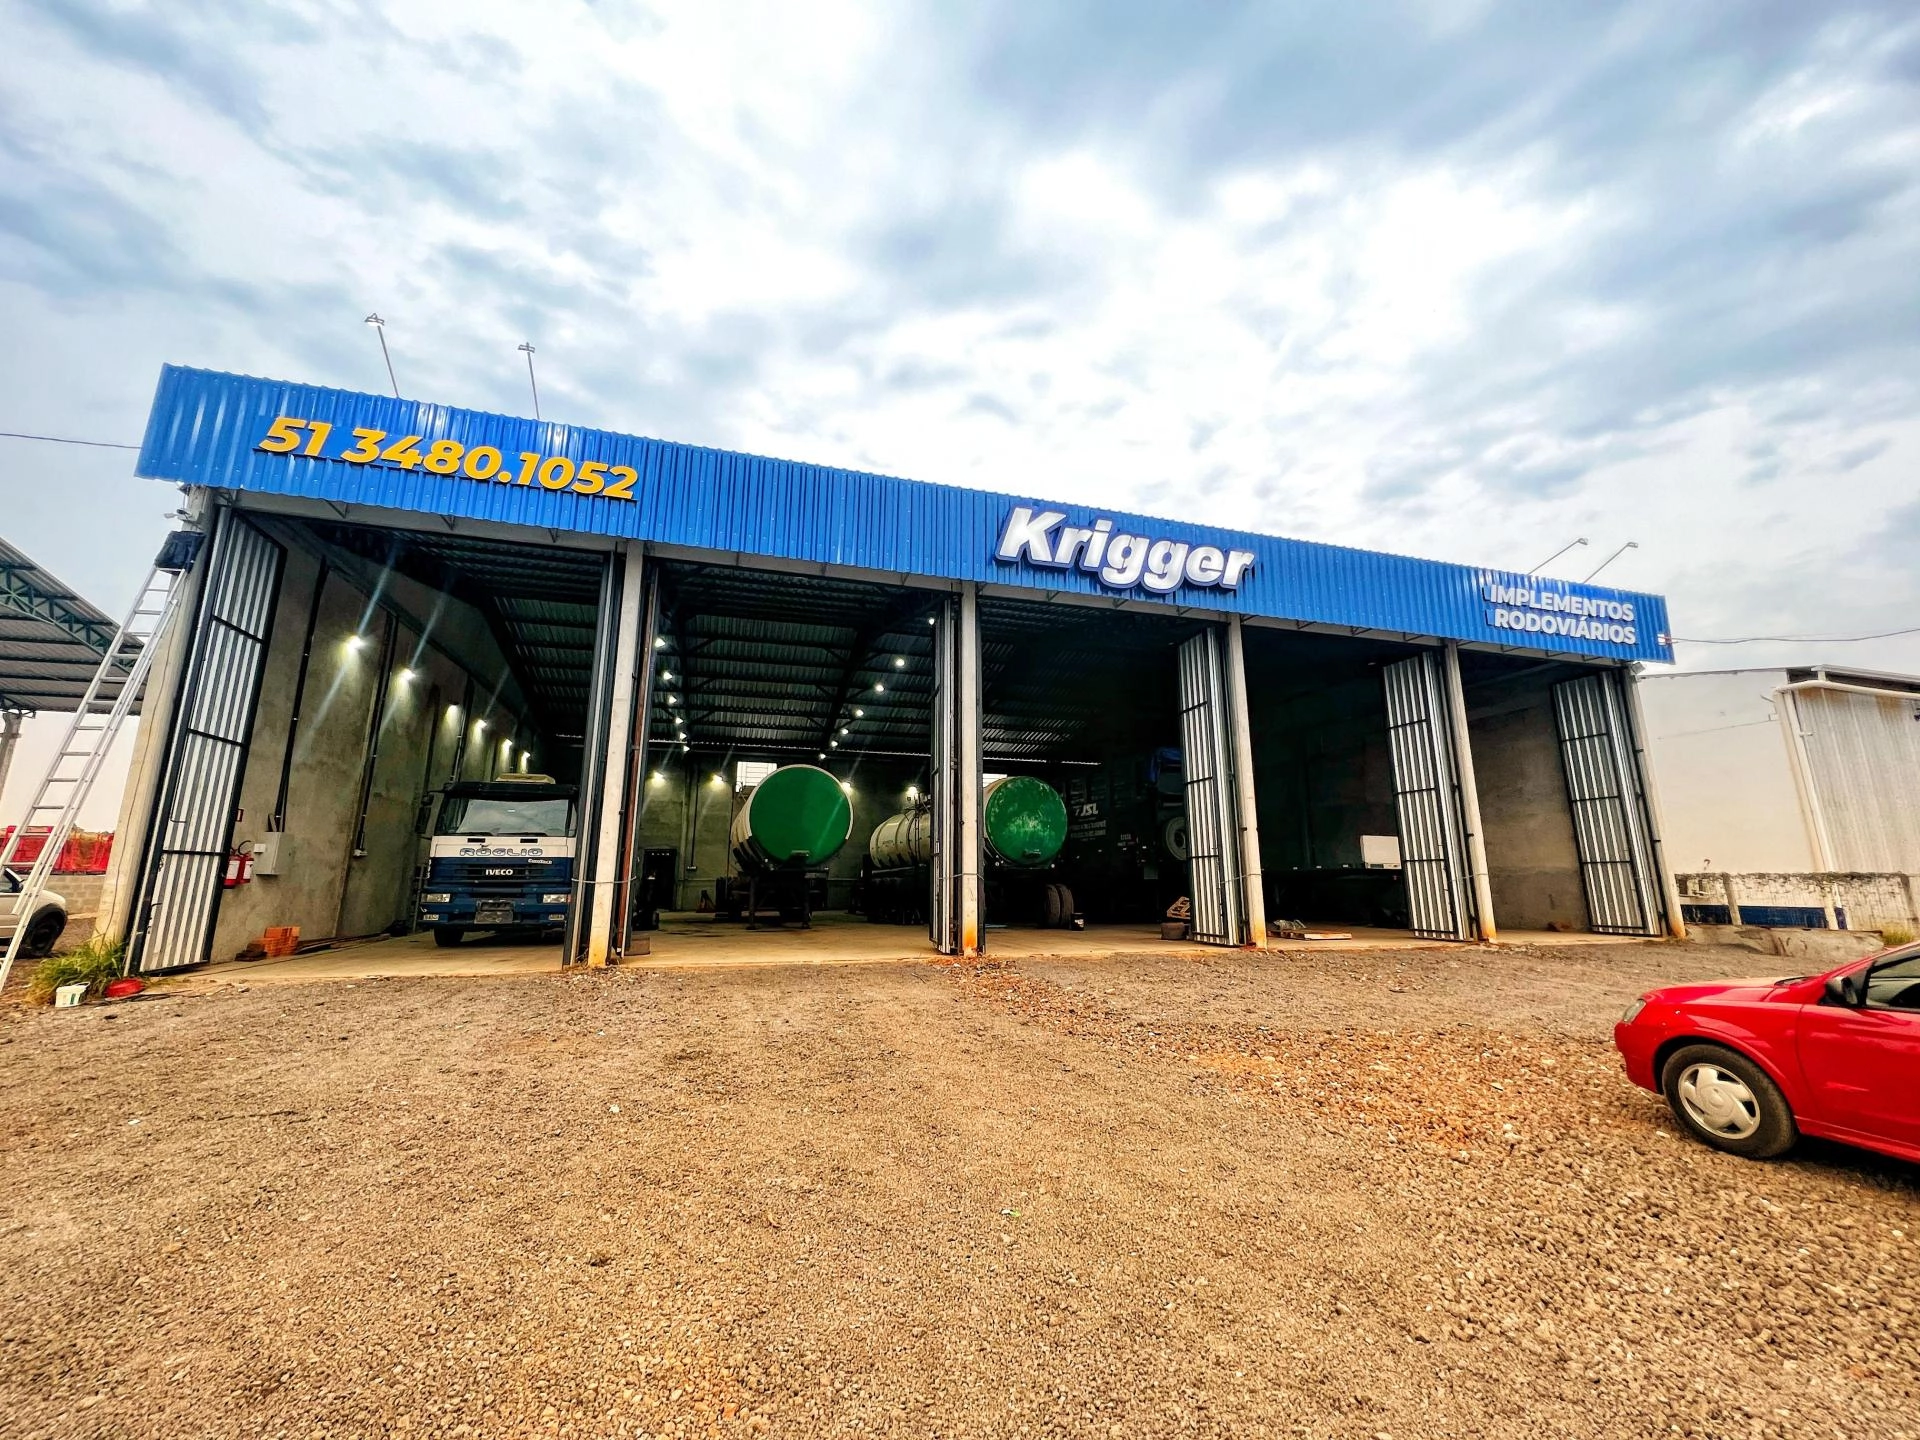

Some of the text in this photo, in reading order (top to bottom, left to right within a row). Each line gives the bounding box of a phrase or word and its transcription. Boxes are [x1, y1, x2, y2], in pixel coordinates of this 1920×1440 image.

[258, 416, 639, 499] 51 3480.1052
[998, 506, 1256, 591] Krigger
[1490, 584, 1635, 622] IMPLEMENTOS
[1494, 608, 1637, 645] RODOVIÁRIOS
